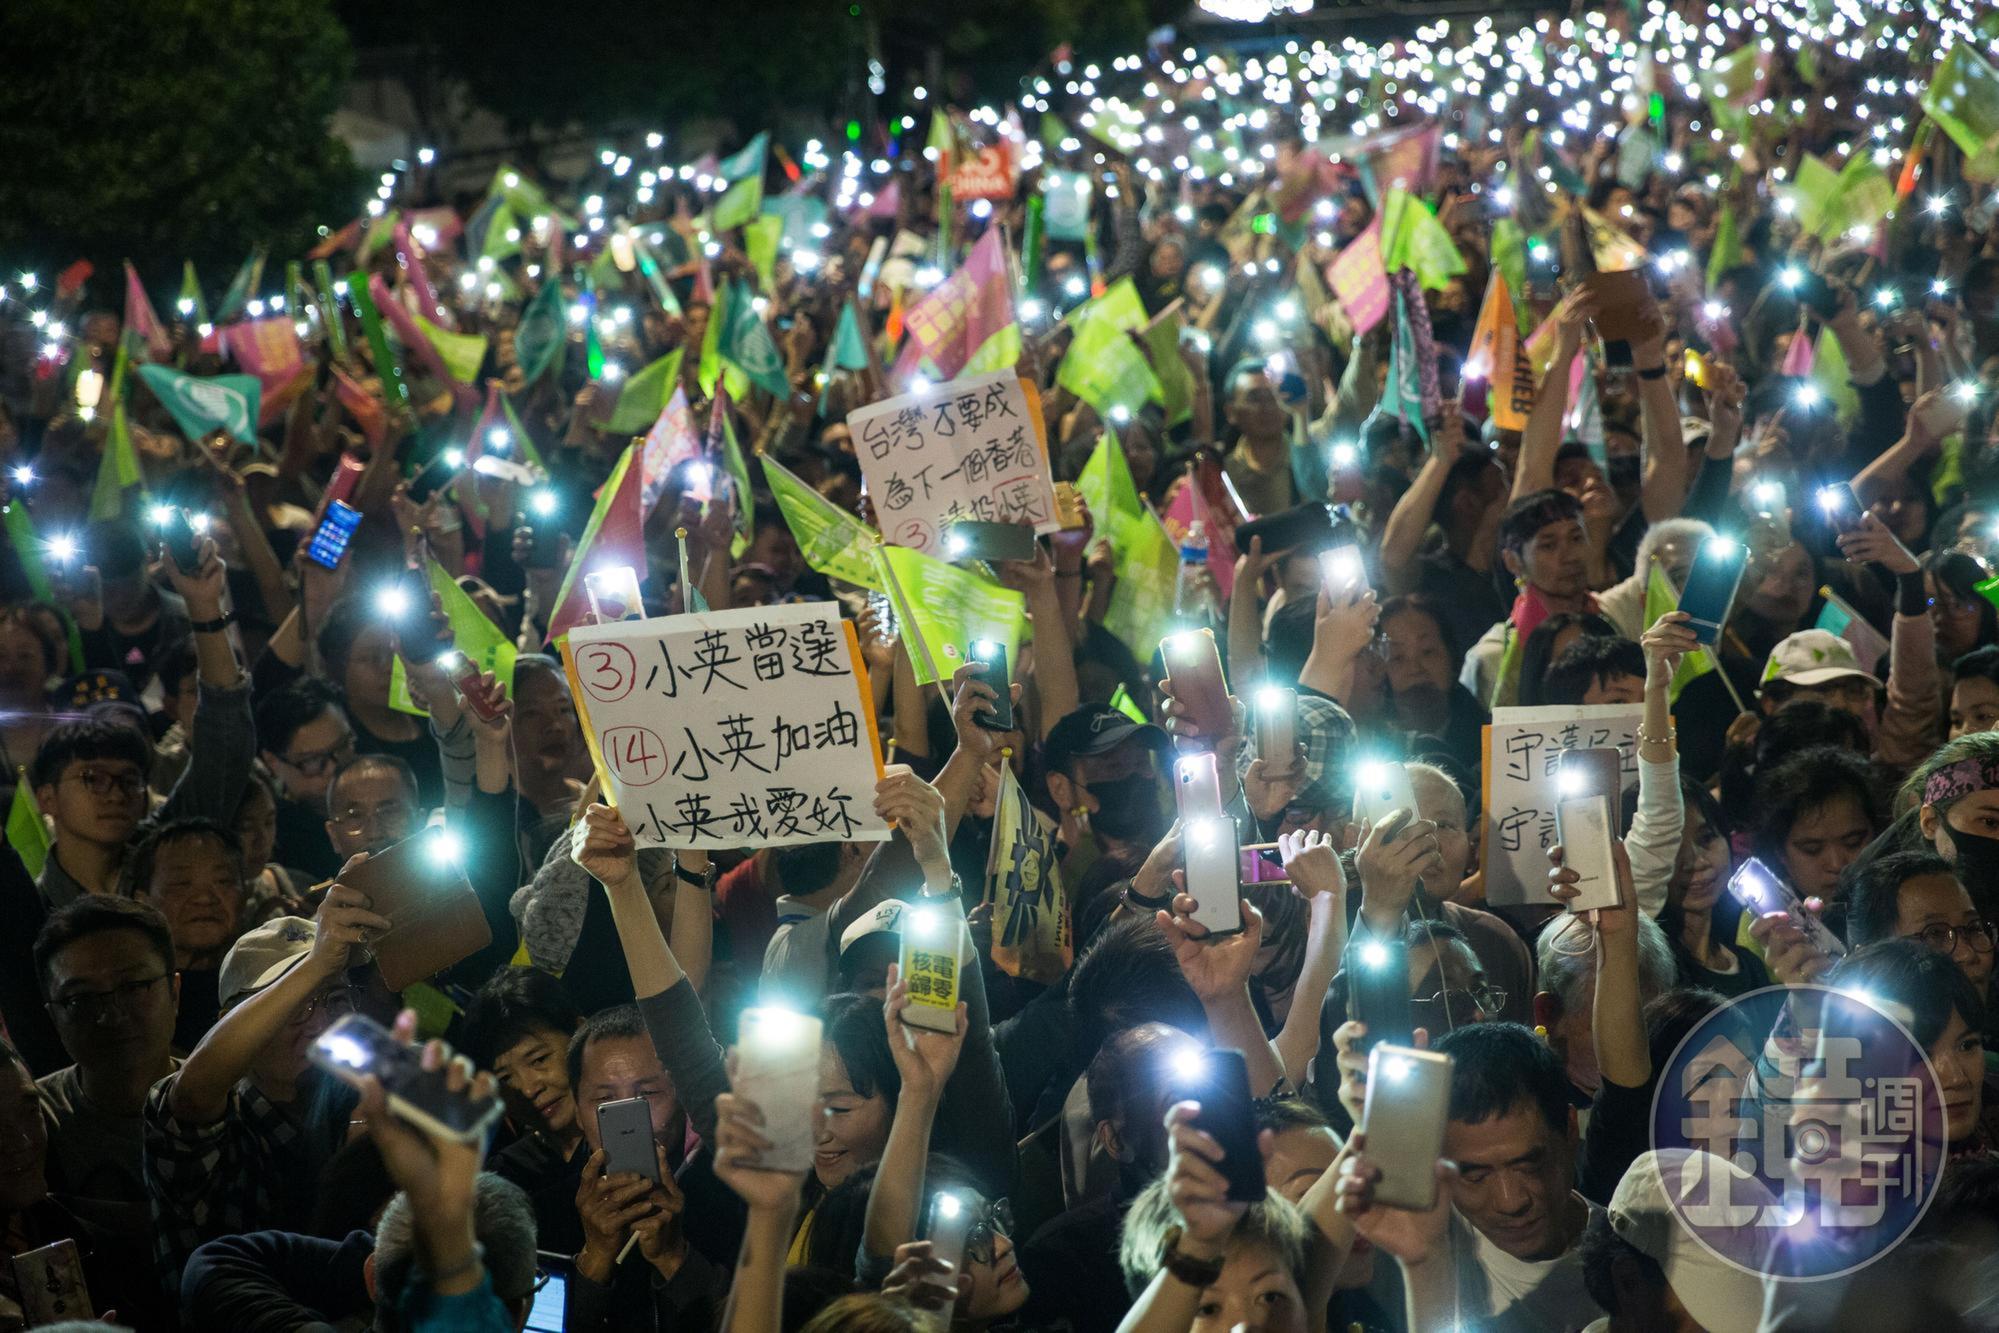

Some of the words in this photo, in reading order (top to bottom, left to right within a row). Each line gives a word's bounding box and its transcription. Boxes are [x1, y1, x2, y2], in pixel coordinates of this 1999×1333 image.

[863, 382, 1018, 460] 台灣不要成
[883, 425, 1036, 511] 為下一個香港
[645, 620, 851, 698] 小英當選
[672, 701, 859, 782] 小英加油
